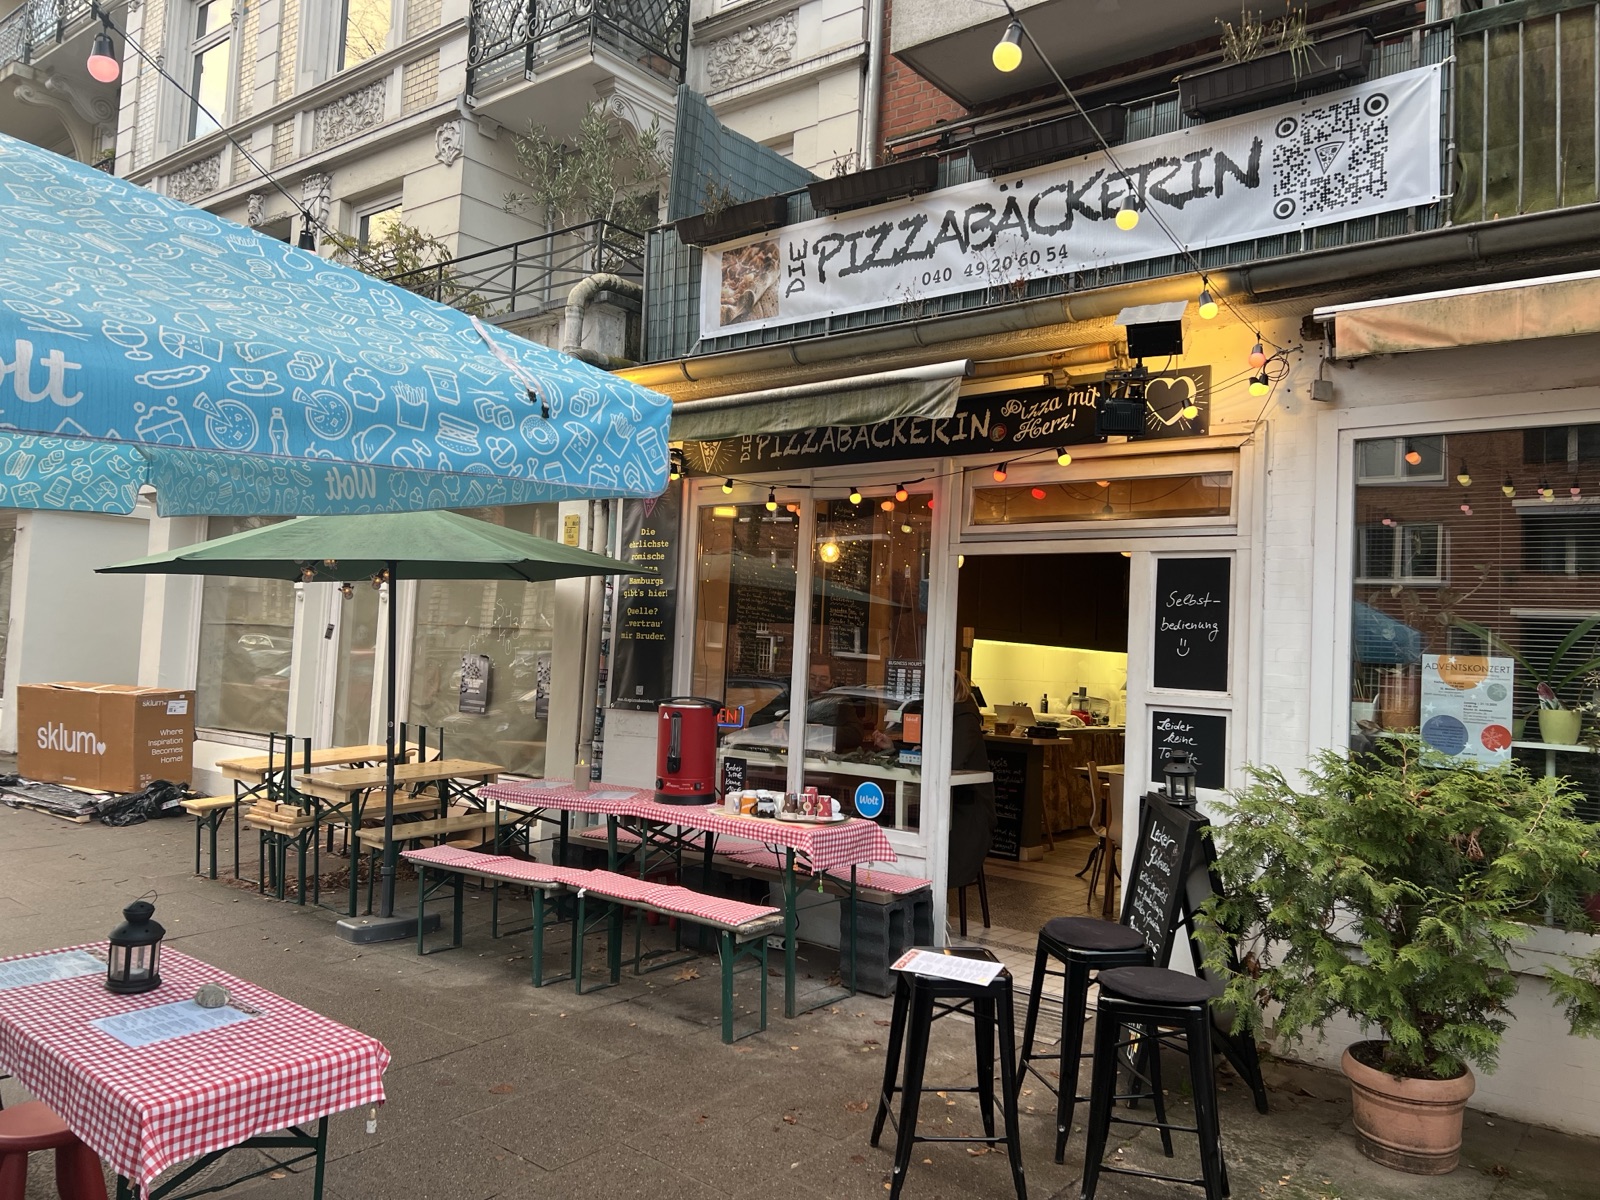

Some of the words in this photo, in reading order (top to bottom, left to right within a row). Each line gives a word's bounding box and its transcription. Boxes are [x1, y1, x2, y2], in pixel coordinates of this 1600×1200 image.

[785, 238, 809, 298] DIE
[812, 136, 1263, 284] PIZZABÄCKERIN
[922, 267, 953, 286] 040
[964, 261, 985, 277] 49
[991, 256, 1013, 273] 20
[1018, 250, 1041, 267] 60
[1046, 244, 1068, 262] 54
[0, 339, 84, 406] lt
[1001, 397, 1063, 421] Pizza
[1067, 385, 1101, 409] mit
[1013, 408, 1077, 442] Herz!
[740, 434, 752, 463] DIE
[641, 528, 656, 536] Die
[629, 540, 669, 549] ehrlichste
[631, 552, 665, 560] römische
[629, 577, 664, 587] Hamburgs
[623, 589, 644, 599] gibt's
[648, 589, 668, 597] hier!
[1166, 590, 1221, 608] Selbst-
[627, 606, 659, 616] Quelle?
[1160, 616, 1220, 643] bedienung
[636, 632, 666, 640] Bruder.
[1424, 662, 1511, 675] ADVENTSKONZERT
[1157, 717, 1195, 732] Leider
[159, 728, 184, 736] Where
[147, 737, 184, 747] Inspiration
[1163, 731, 1198, 746] keine
[151, 746, 184, 756] Becomes
[160, 755, 183, 764] Home!
[859, 795, 879, 806] Wolt
